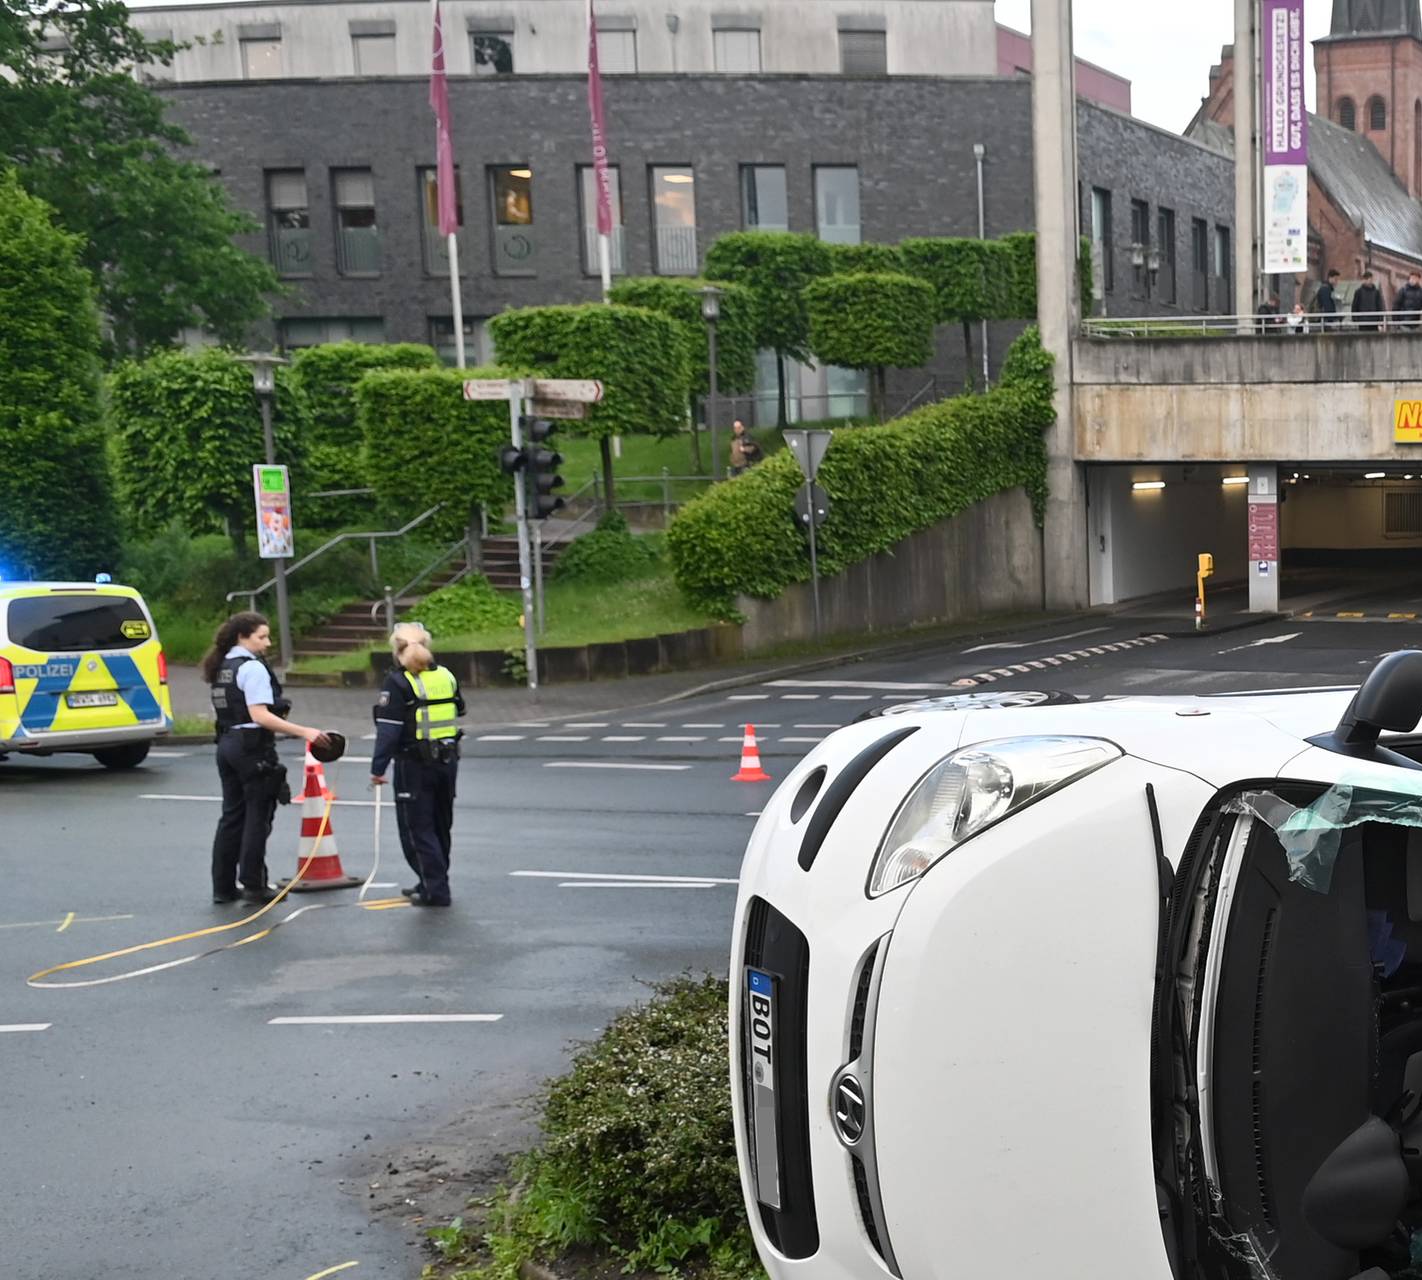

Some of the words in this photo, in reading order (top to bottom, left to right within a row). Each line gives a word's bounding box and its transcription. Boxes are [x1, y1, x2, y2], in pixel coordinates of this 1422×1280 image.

[1276, 108, 1285, 148] HALLO
[15, 664, 73, 678] POLIZEI
[752, 994, 772, 1065] BOT
